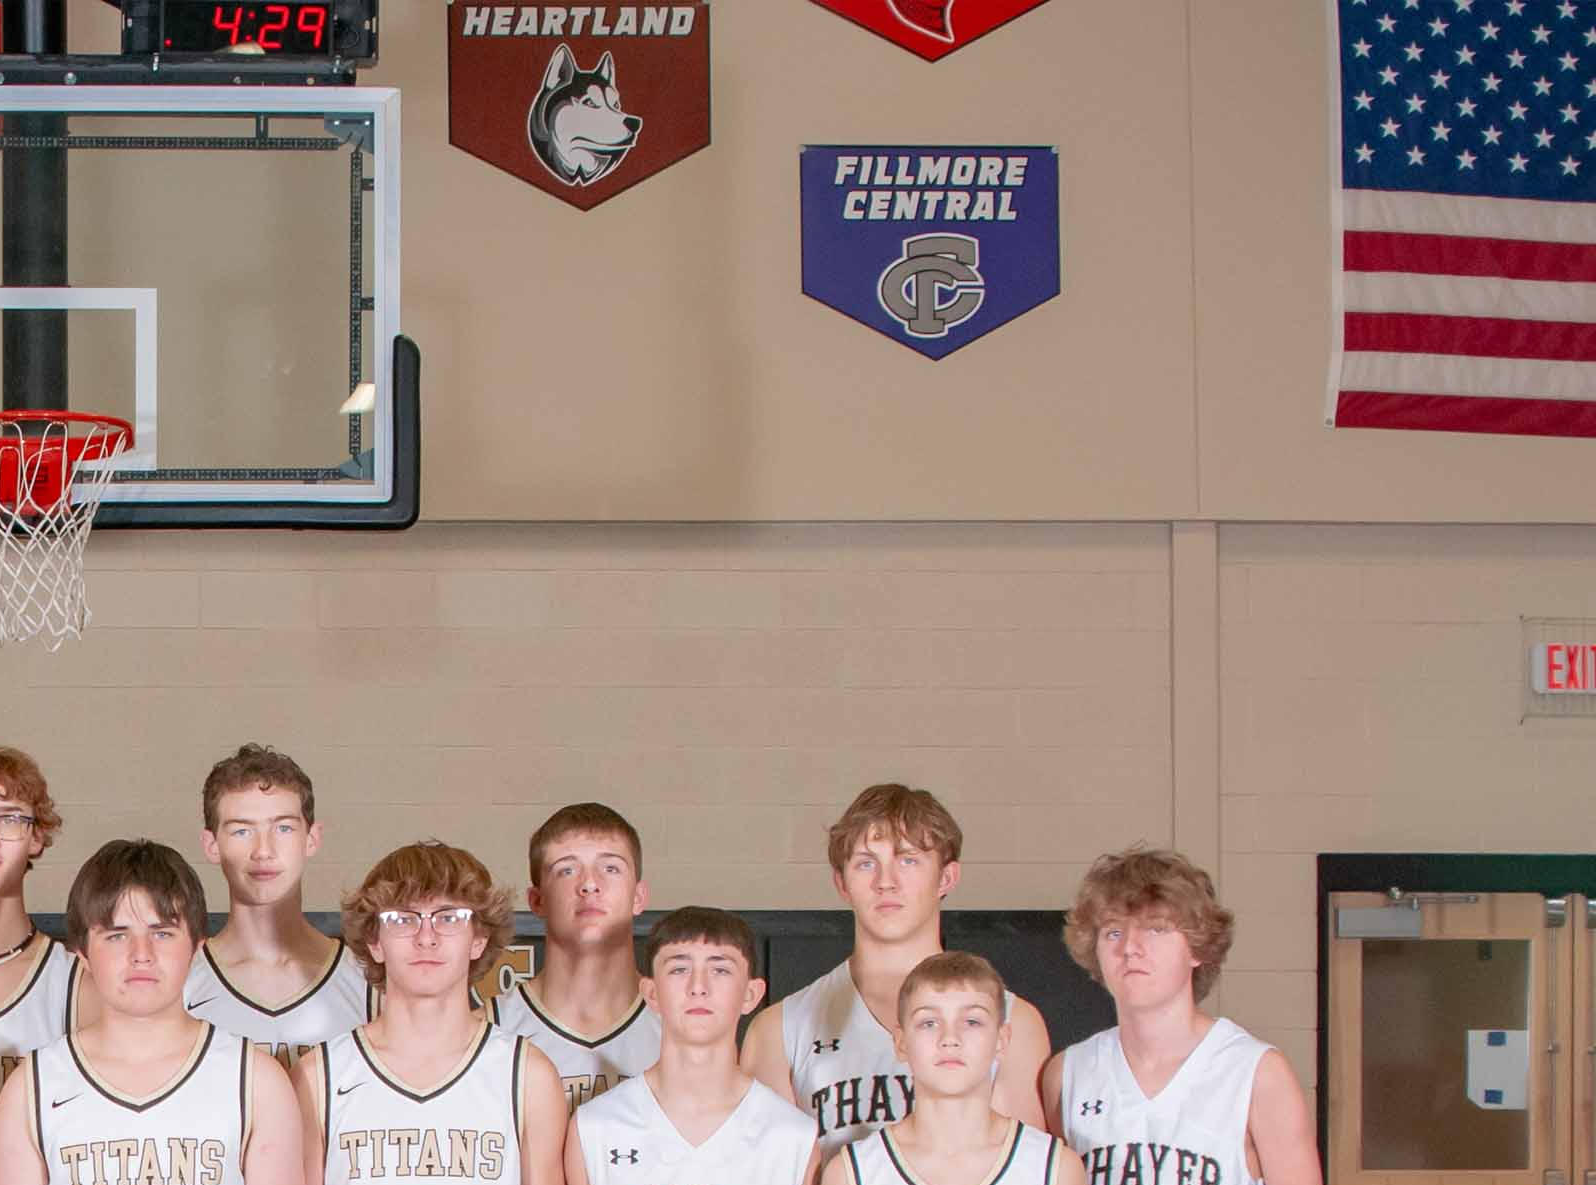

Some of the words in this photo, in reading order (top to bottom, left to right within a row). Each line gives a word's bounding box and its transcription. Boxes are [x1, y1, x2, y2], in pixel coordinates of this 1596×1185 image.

[212, 5, 326, 48] 4:29
[463, 6, 695, 36] HEARTLAND
[834, 156, 1029, 187] FILLMORE
[843, 190, 1019, 221] CENTRAL
[339, 1128, 505, 1180] TITANS
